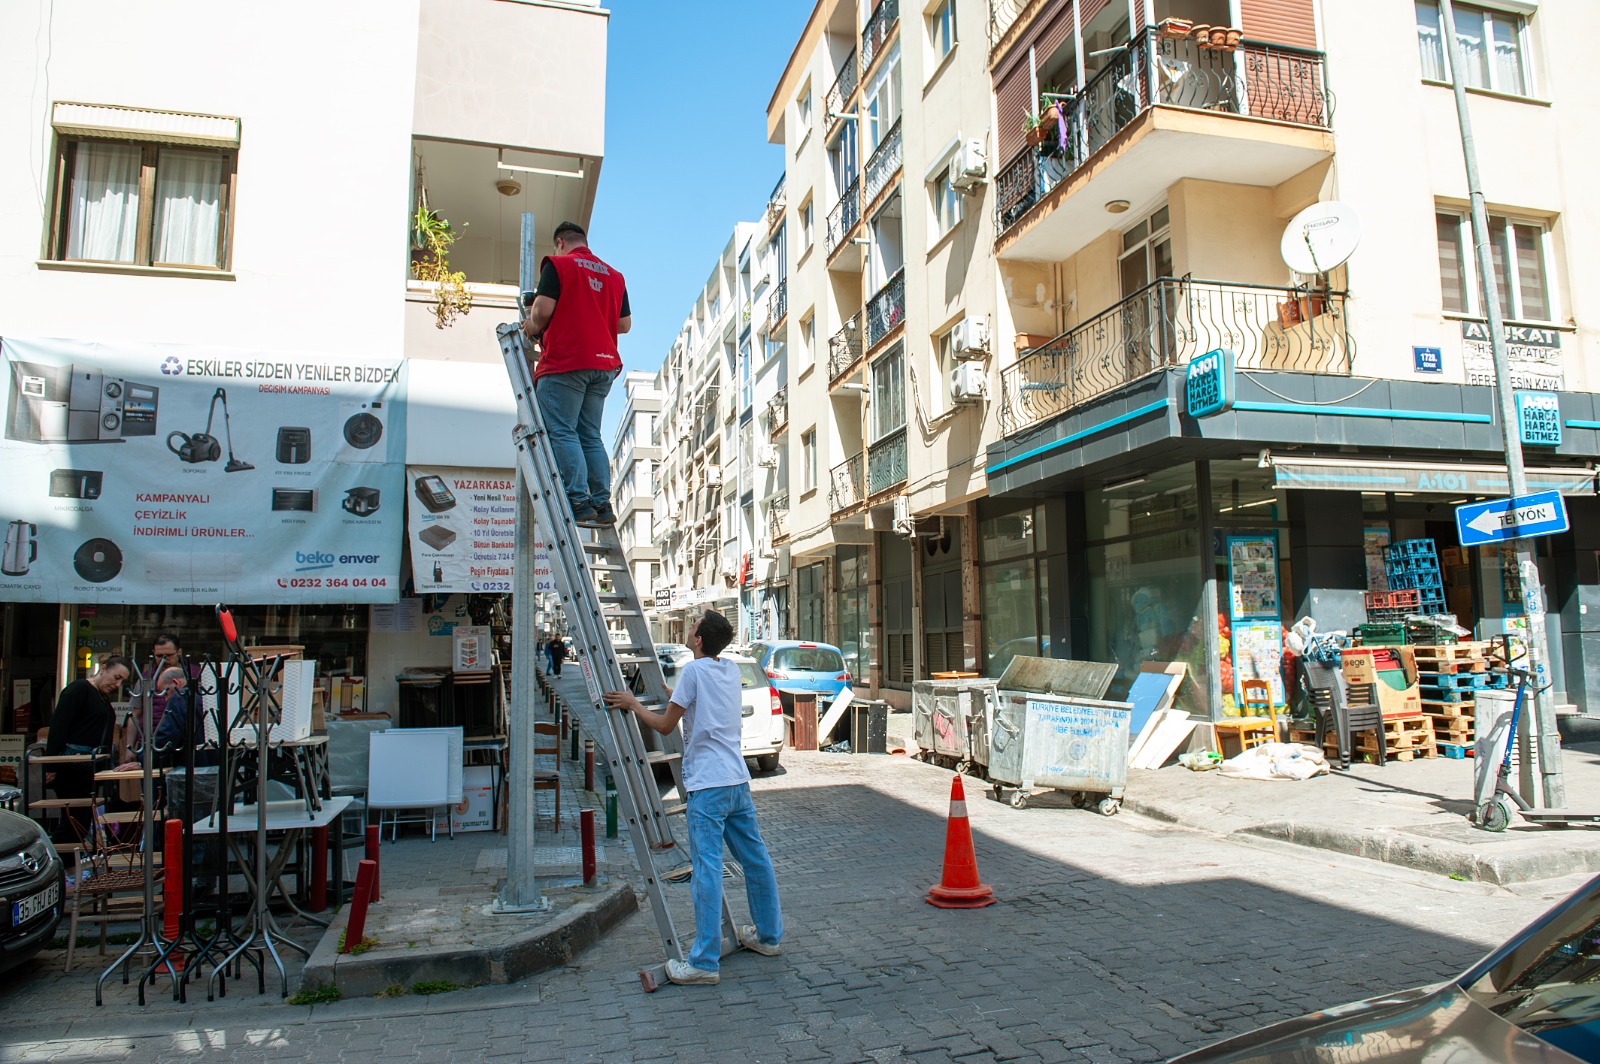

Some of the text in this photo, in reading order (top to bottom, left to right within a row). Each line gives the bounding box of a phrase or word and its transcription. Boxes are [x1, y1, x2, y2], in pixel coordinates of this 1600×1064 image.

[187, 358, 399, 383] ESKİLER SİZDEN YENİLER BİZDEN
[1189, 369, 1218, 389] HARCA
[1190, 382, 1218, 401] HARCA
[1524, 412, 1557, 421] HARCA
[1525, 421, 1558, 431] HARCA
[136, 493, 210, 503] KAMPANYALI
[135, 508, 187, 520] ÇEYİZLİK
[473, 506, 489, 514] Kolay
[1518, 508, 1546, 521] YÖN
[473, 518, 515, 526] Kolay Taşınabil
[133, 525, 188, 536] İNDİRİMLİ
[473, 541, 515, 549] Bütün Bankala
[296, 551, 379, 565] beko enver
[470, 566, 486, 577] Peşin
[534, 566, 549, 575] ervis
[290, 578, 386, 588] 0232 364 04 04
[483, 582, 510, 590] 0232
[537, 582, 550, 590] 04
[1349, 659, 1365, 668] ege
[20, 901, 29, 920] 35
